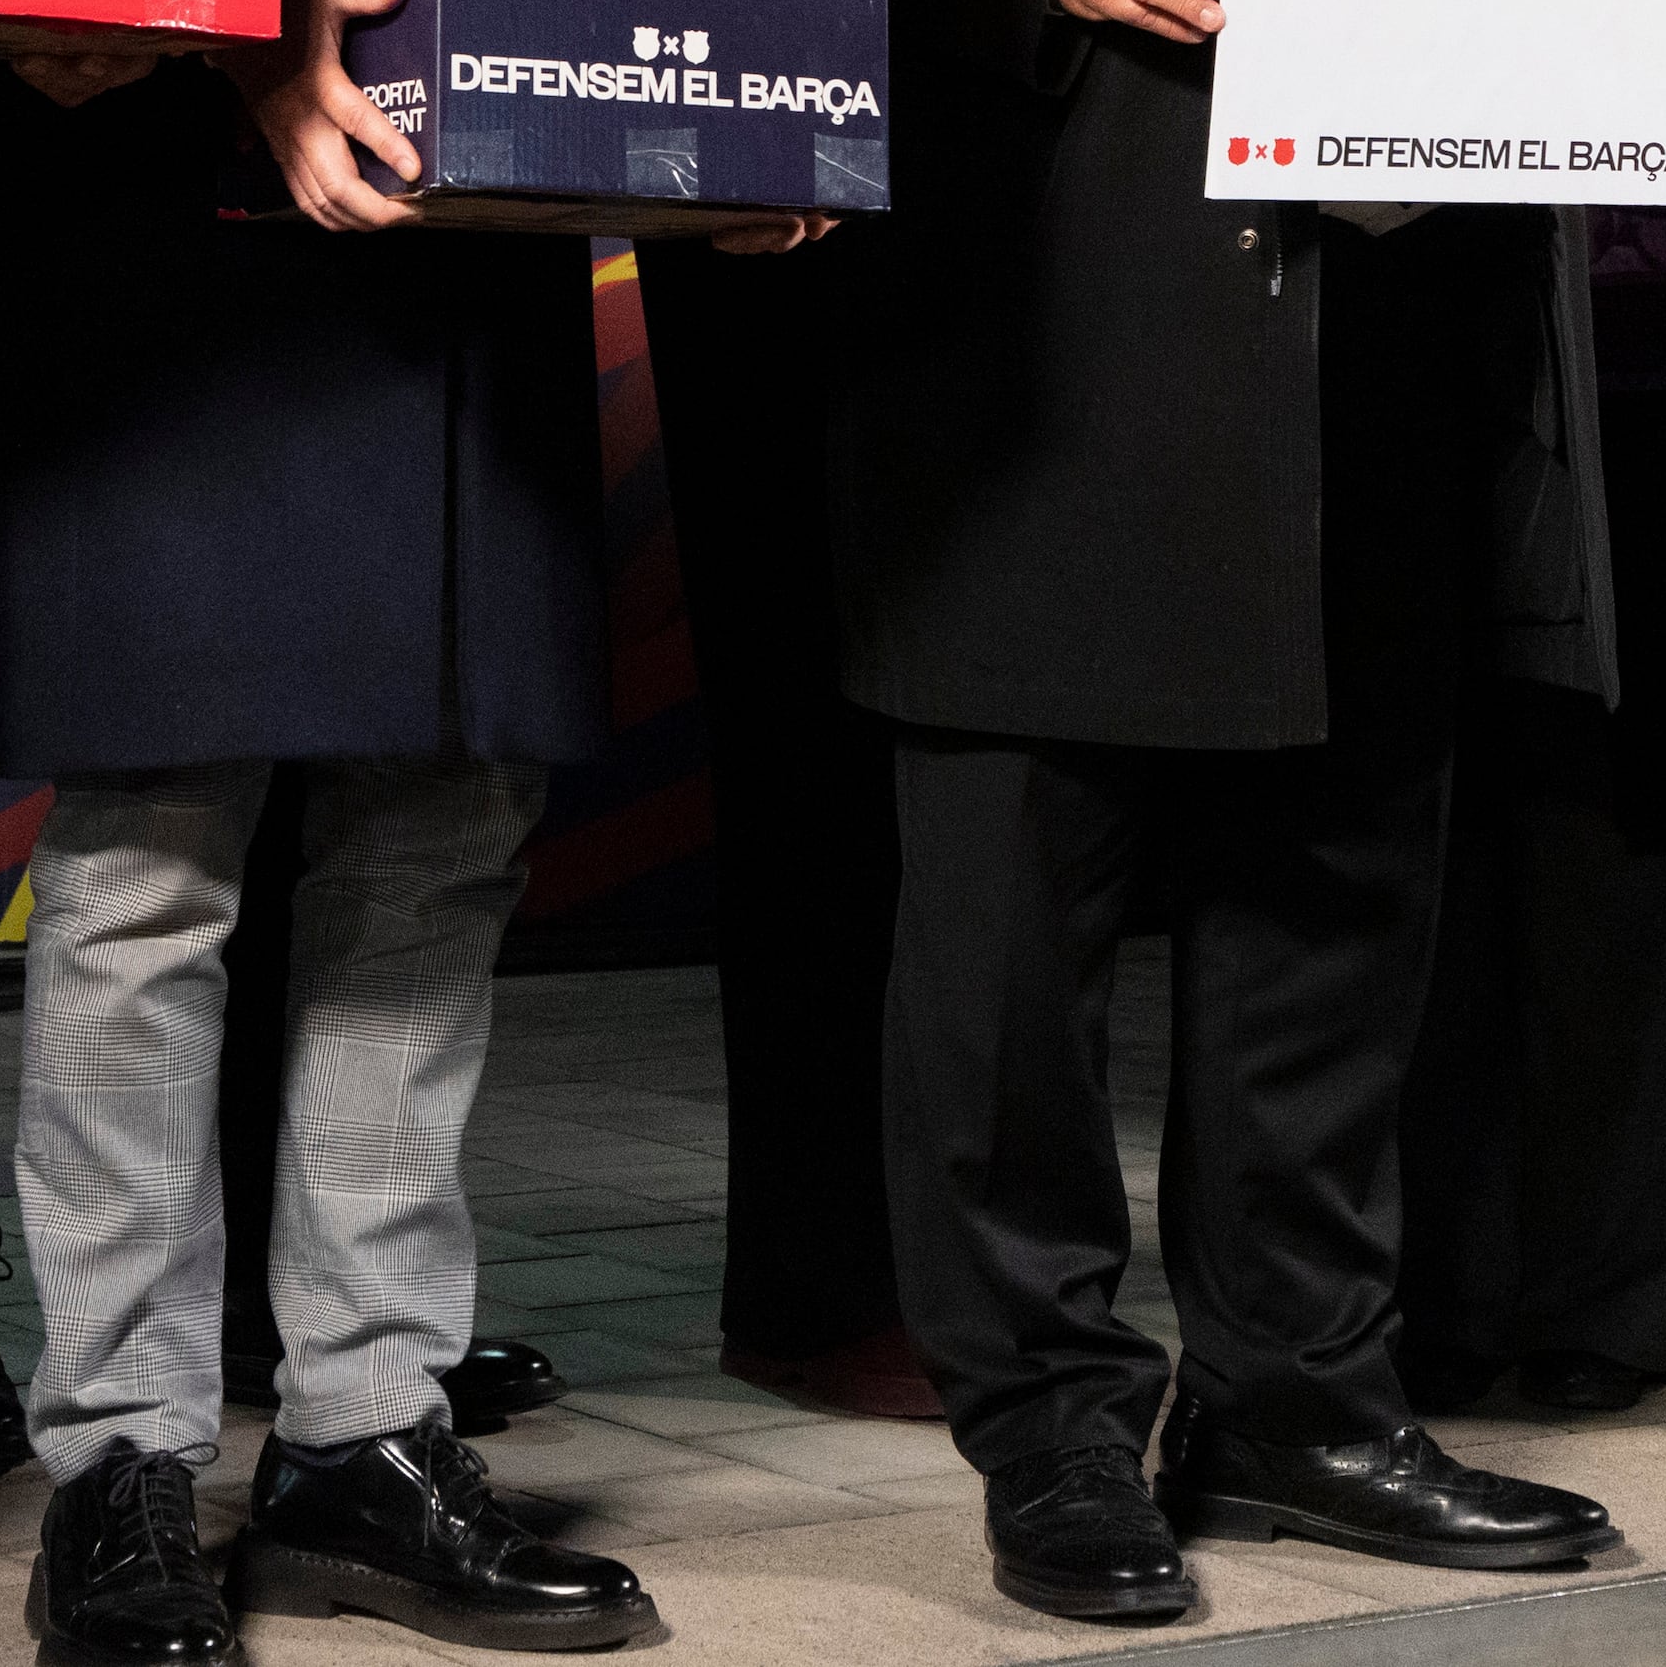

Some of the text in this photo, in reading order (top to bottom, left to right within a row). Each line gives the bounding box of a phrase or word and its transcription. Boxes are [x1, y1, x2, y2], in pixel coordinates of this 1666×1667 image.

[363, 79, 427, 108] PORTA
[450, 53, 881, 126] DEFENSEM EL BARÇA
[1317, 135, 1511, 170] DEFENSEM
[1518, 139, 1560, 171] EL
